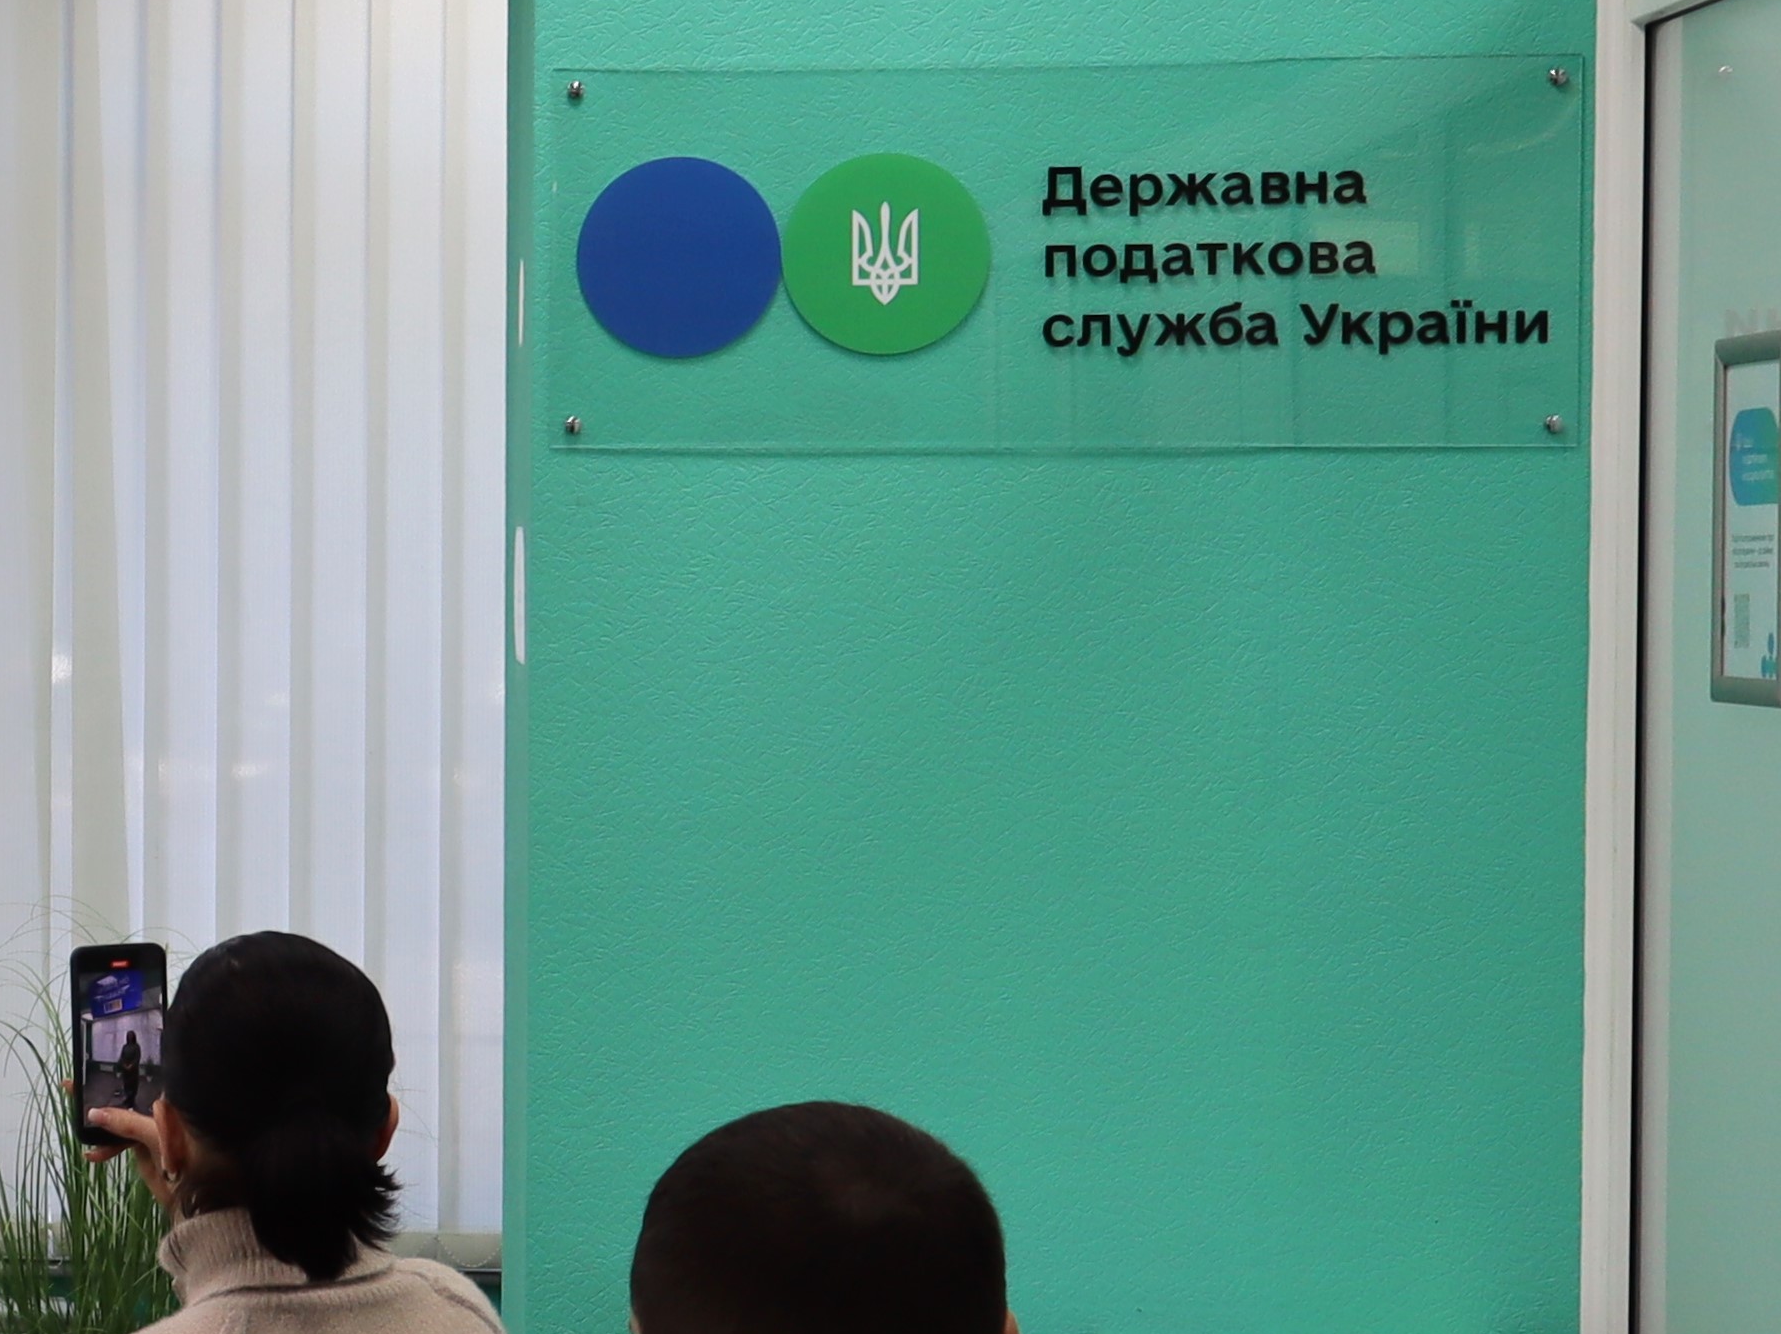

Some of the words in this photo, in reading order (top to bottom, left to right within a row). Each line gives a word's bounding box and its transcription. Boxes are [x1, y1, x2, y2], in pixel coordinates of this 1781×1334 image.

[1040, 164, 1368, 218] Державна
[1043, 239, 1377, 286] податкова
[1041, 301, 1280, 360] служба
[1298, 299, 1550, 357] України
